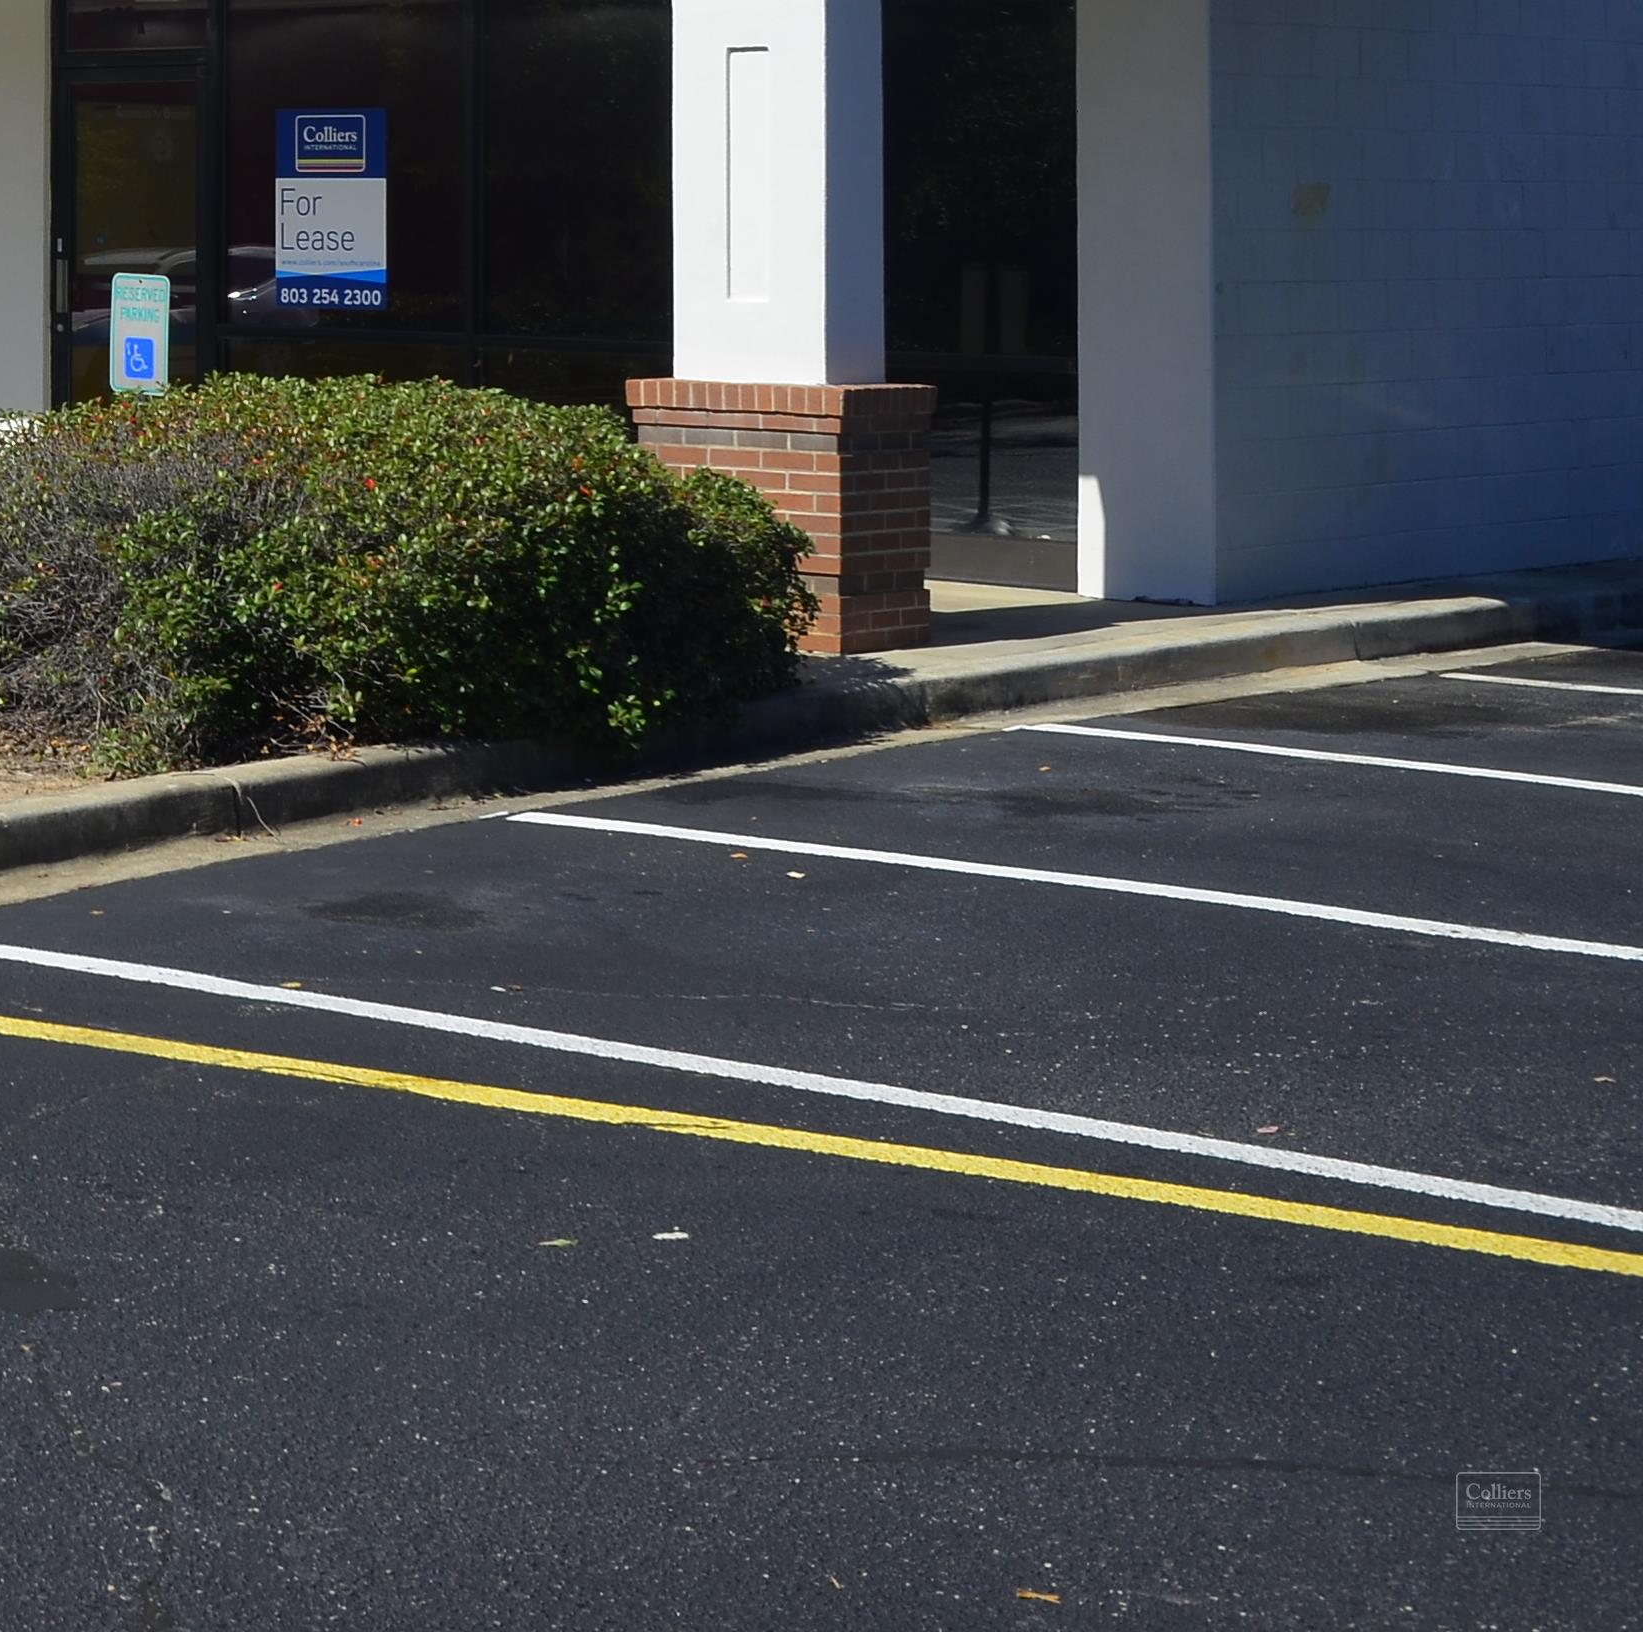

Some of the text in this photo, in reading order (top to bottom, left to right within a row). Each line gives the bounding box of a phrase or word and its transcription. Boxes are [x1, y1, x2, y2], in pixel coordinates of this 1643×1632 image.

[303, 126, 358, 143] Colliers
[280, 187, 323, 217] For
[280, 222, 356, 252] Lease
[116, 287, 165, 303] RESERVED
[280, 287, 382, 306] 803 254 2300
[120, 306, 160, 323] PARKING
